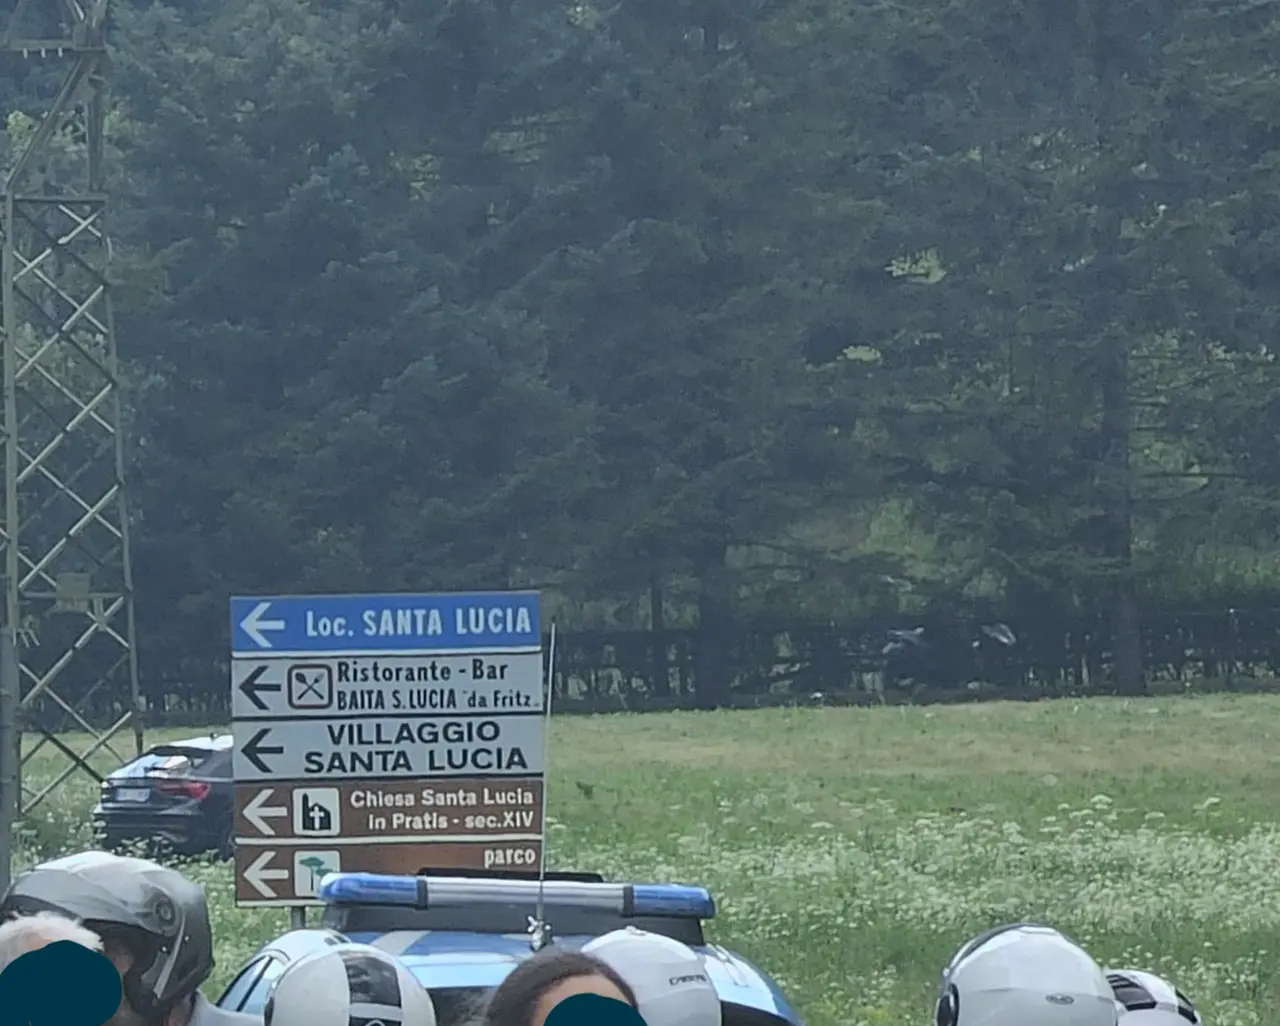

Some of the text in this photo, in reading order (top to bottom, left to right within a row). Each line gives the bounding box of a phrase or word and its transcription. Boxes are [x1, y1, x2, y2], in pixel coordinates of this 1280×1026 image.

[306, 607, 531, 637] Loc. SANTA LUCIA
[337, 660, 452, 682] Ristorante
[472, 658, 508, 680] Bar
[337, 689, 385, 710] BAITA
[327, 720, 501, 745] VILLAGGIO
[304, 747, 528, 774] SANTA LUCIA
[350, 788, 533, 807] Chiesa Santa Lucia
[392, 812, 448, 829] Pratis
[483, 848, 536, 868] parco
